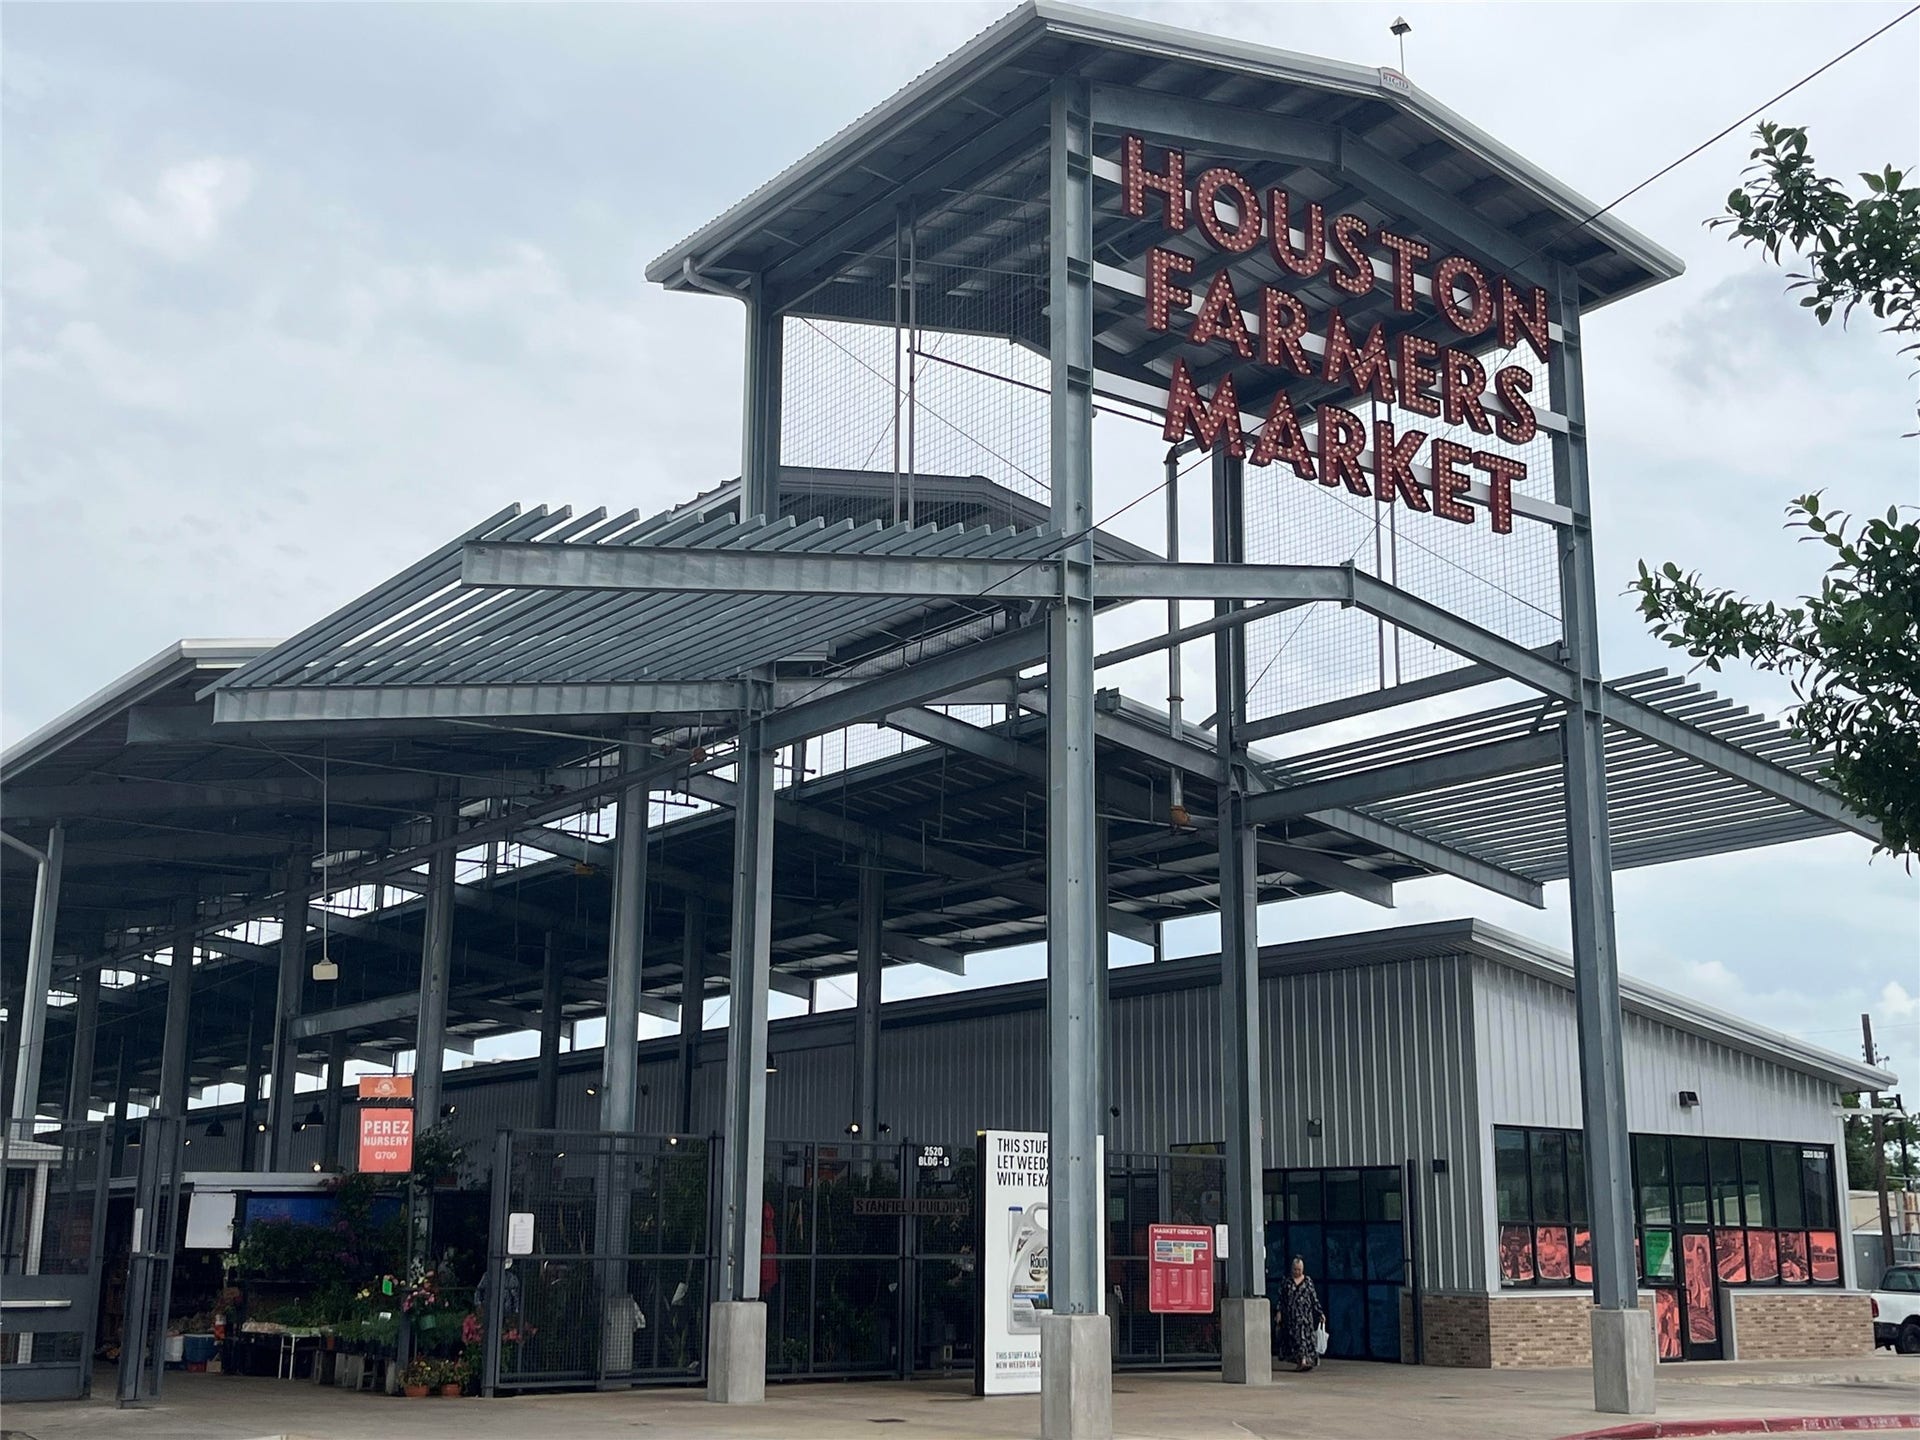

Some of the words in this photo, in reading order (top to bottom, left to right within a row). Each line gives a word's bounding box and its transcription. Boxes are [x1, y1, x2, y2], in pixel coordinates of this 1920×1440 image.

[1122, 134, 1550, 364] HOUSTON
[1146, 246, 1537, 445] FARMERS
[1163, 356, 1527, 535] MARKET
[364, 1120, 410, 1135] PEREZ
[363, 1136, 409, 1146] NURSERY
[997, 1138, 1020, 1153] THIS
[1023, 1139, 1048, 1154] STUF
[924, 1146, 943, 1157] 2520
[918, 1156, 938, 1167] BLDG
[997, 1155, 1015, 1169] LET
[997, 1171, 1024, 1186] WITH
